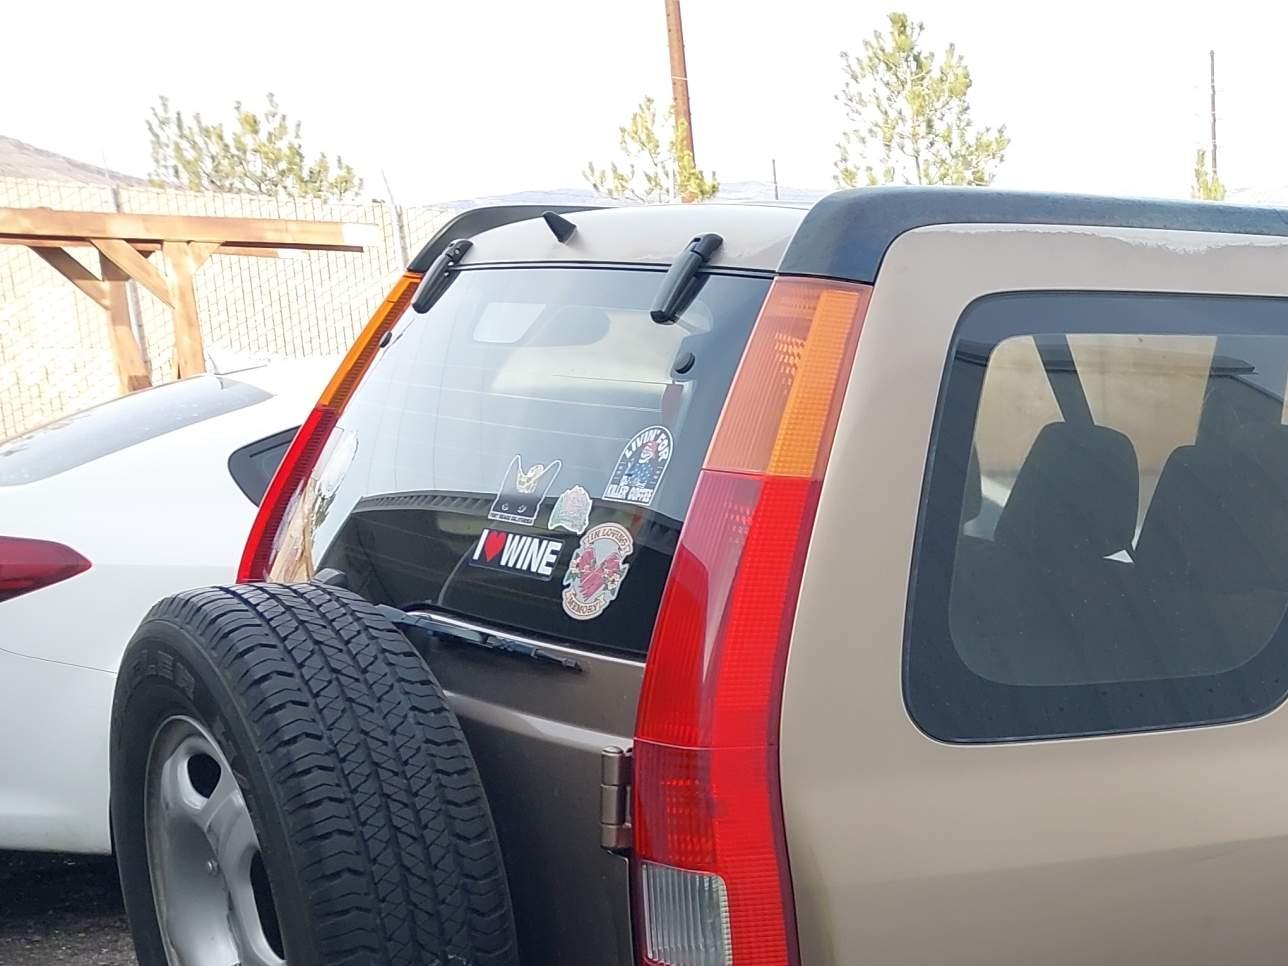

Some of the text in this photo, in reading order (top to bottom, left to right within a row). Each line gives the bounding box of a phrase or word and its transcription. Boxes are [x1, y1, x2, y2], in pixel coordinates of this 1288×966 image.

[656, 432, 669, 462] FOR
[590, 528, 628, 547] IN LOVING
[472, 529, 563, 576] I WINE
[567, 598, 600, 614] MEMORY
